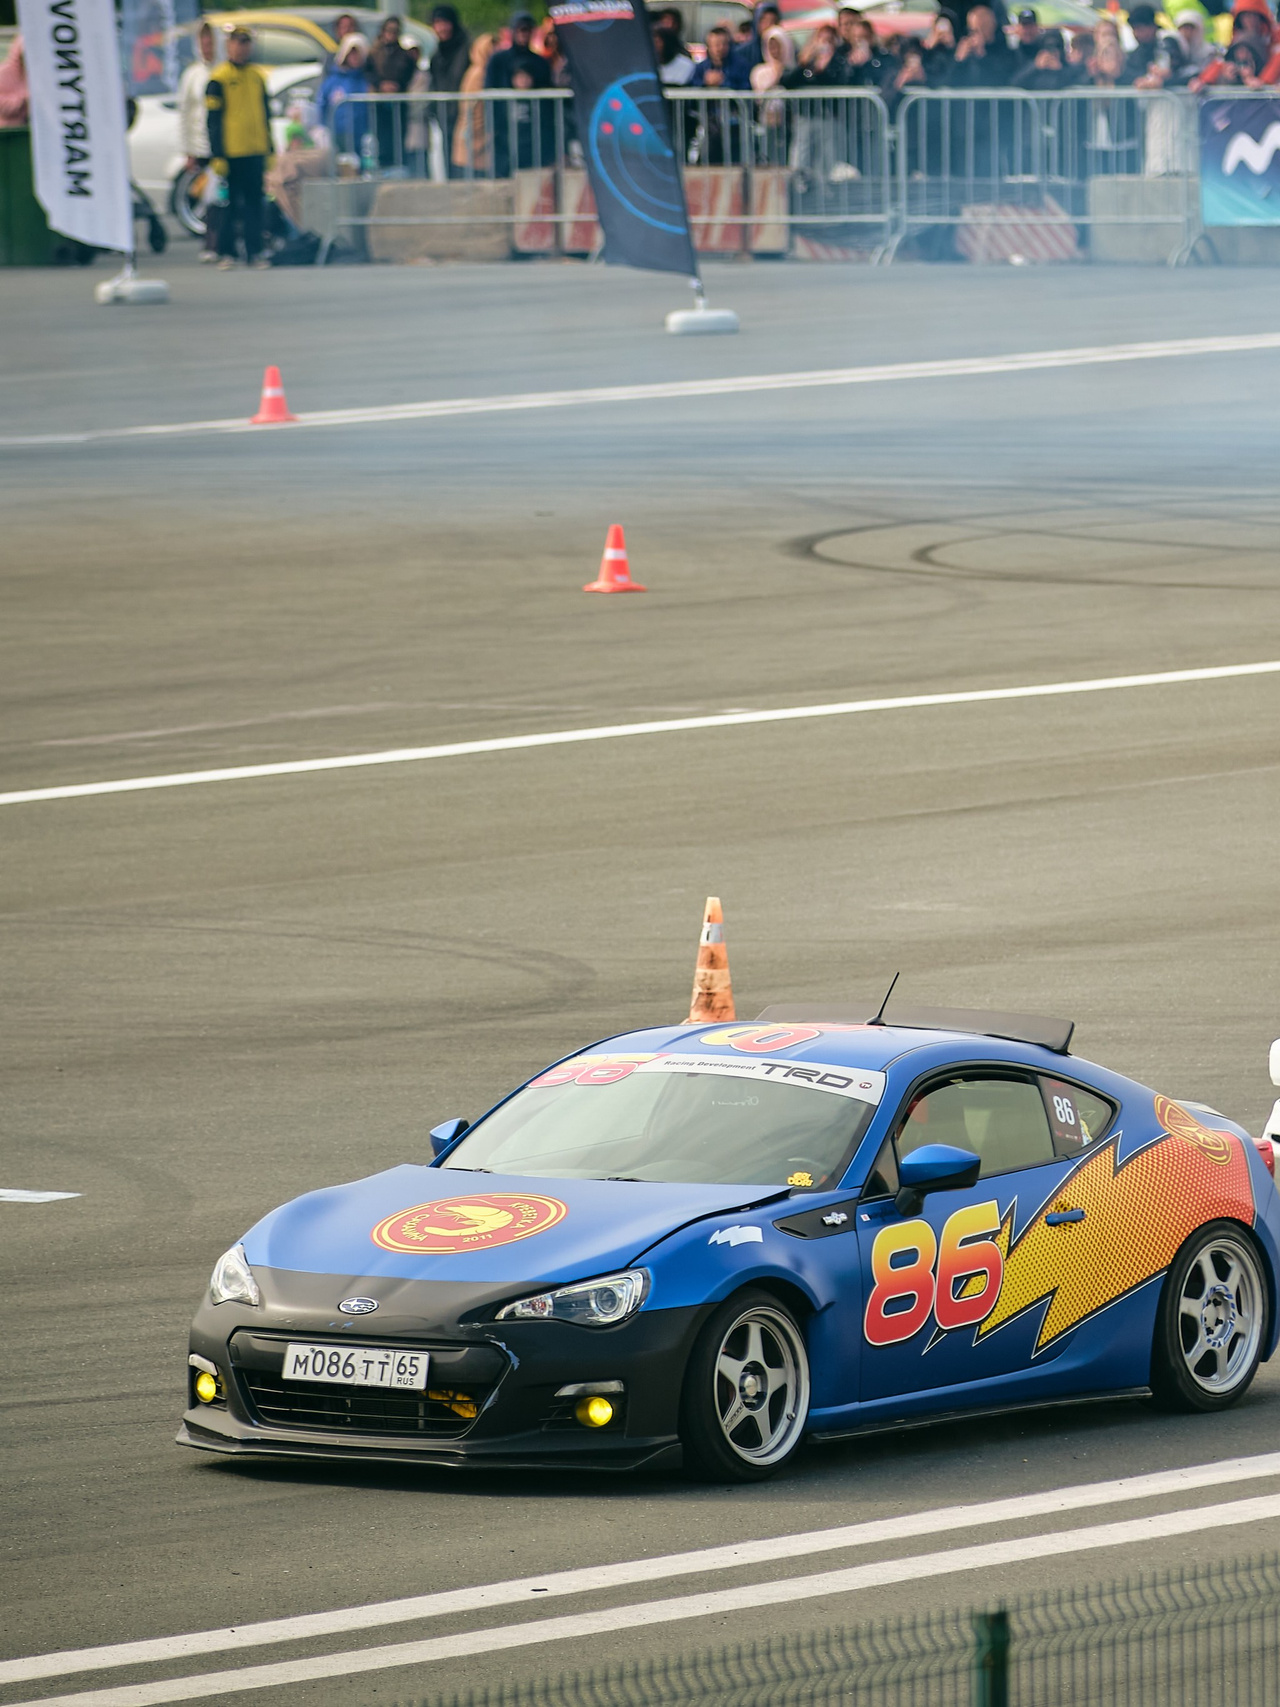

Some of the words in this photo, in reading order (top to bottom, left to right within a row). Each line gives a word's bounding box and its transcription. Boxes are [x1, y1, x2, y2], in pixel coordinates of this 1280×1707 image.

[527, 1053, 674, 1089] 86
[697, 1061, 757, 1072] Development
[760, 1062, 854, 1089] TRD
[1052, 1095, 1076, 1126] 86
[462, 1233, 493, 1243] 2011
[863, 1198, 1005, 1346] 86
[396, 1355, 420, 1376] 65
[397, 1377, 415, 1386] RUS
